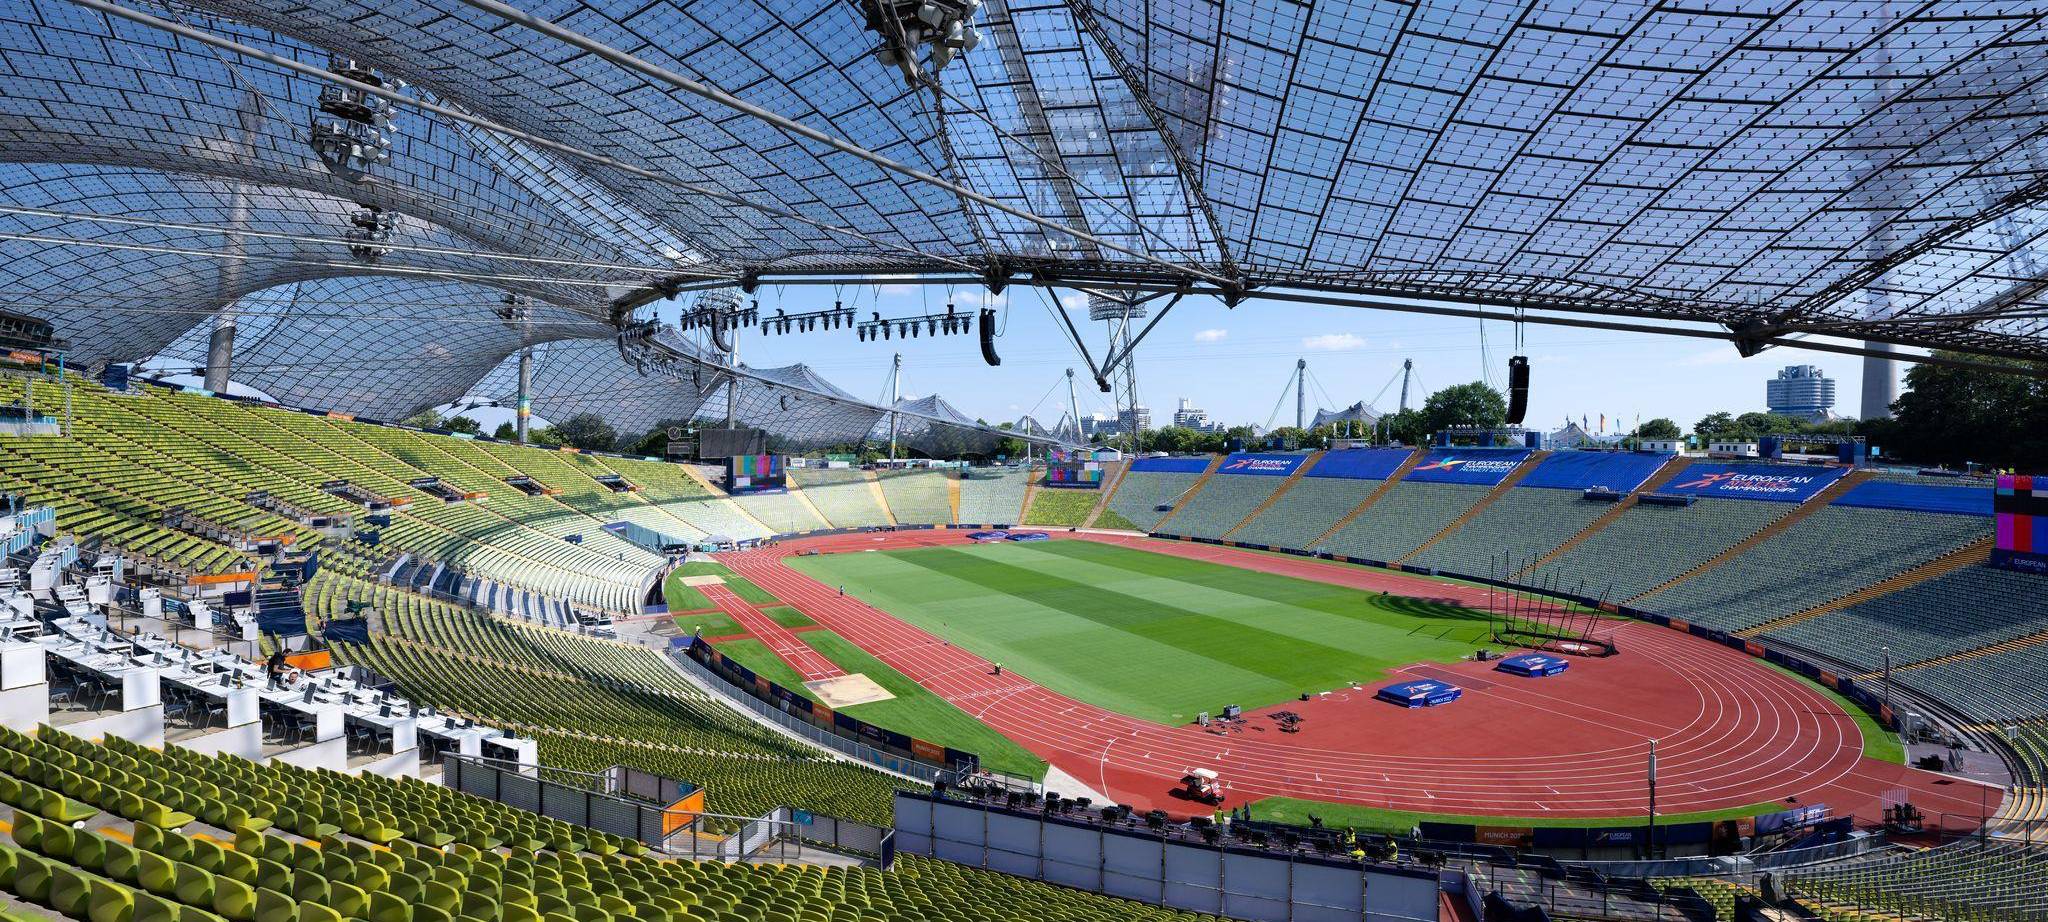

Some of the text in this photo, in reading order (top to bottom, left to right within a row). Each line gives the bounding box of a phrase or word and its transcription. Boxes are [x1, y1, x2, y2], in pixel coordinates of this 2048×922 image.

[1730, 474, 1813, 483] EUROPEAN
[1720, 485, 1799, 493] CHAMPIONSHIPS
[2014, 558, 2047, 568] EUROPEAN
